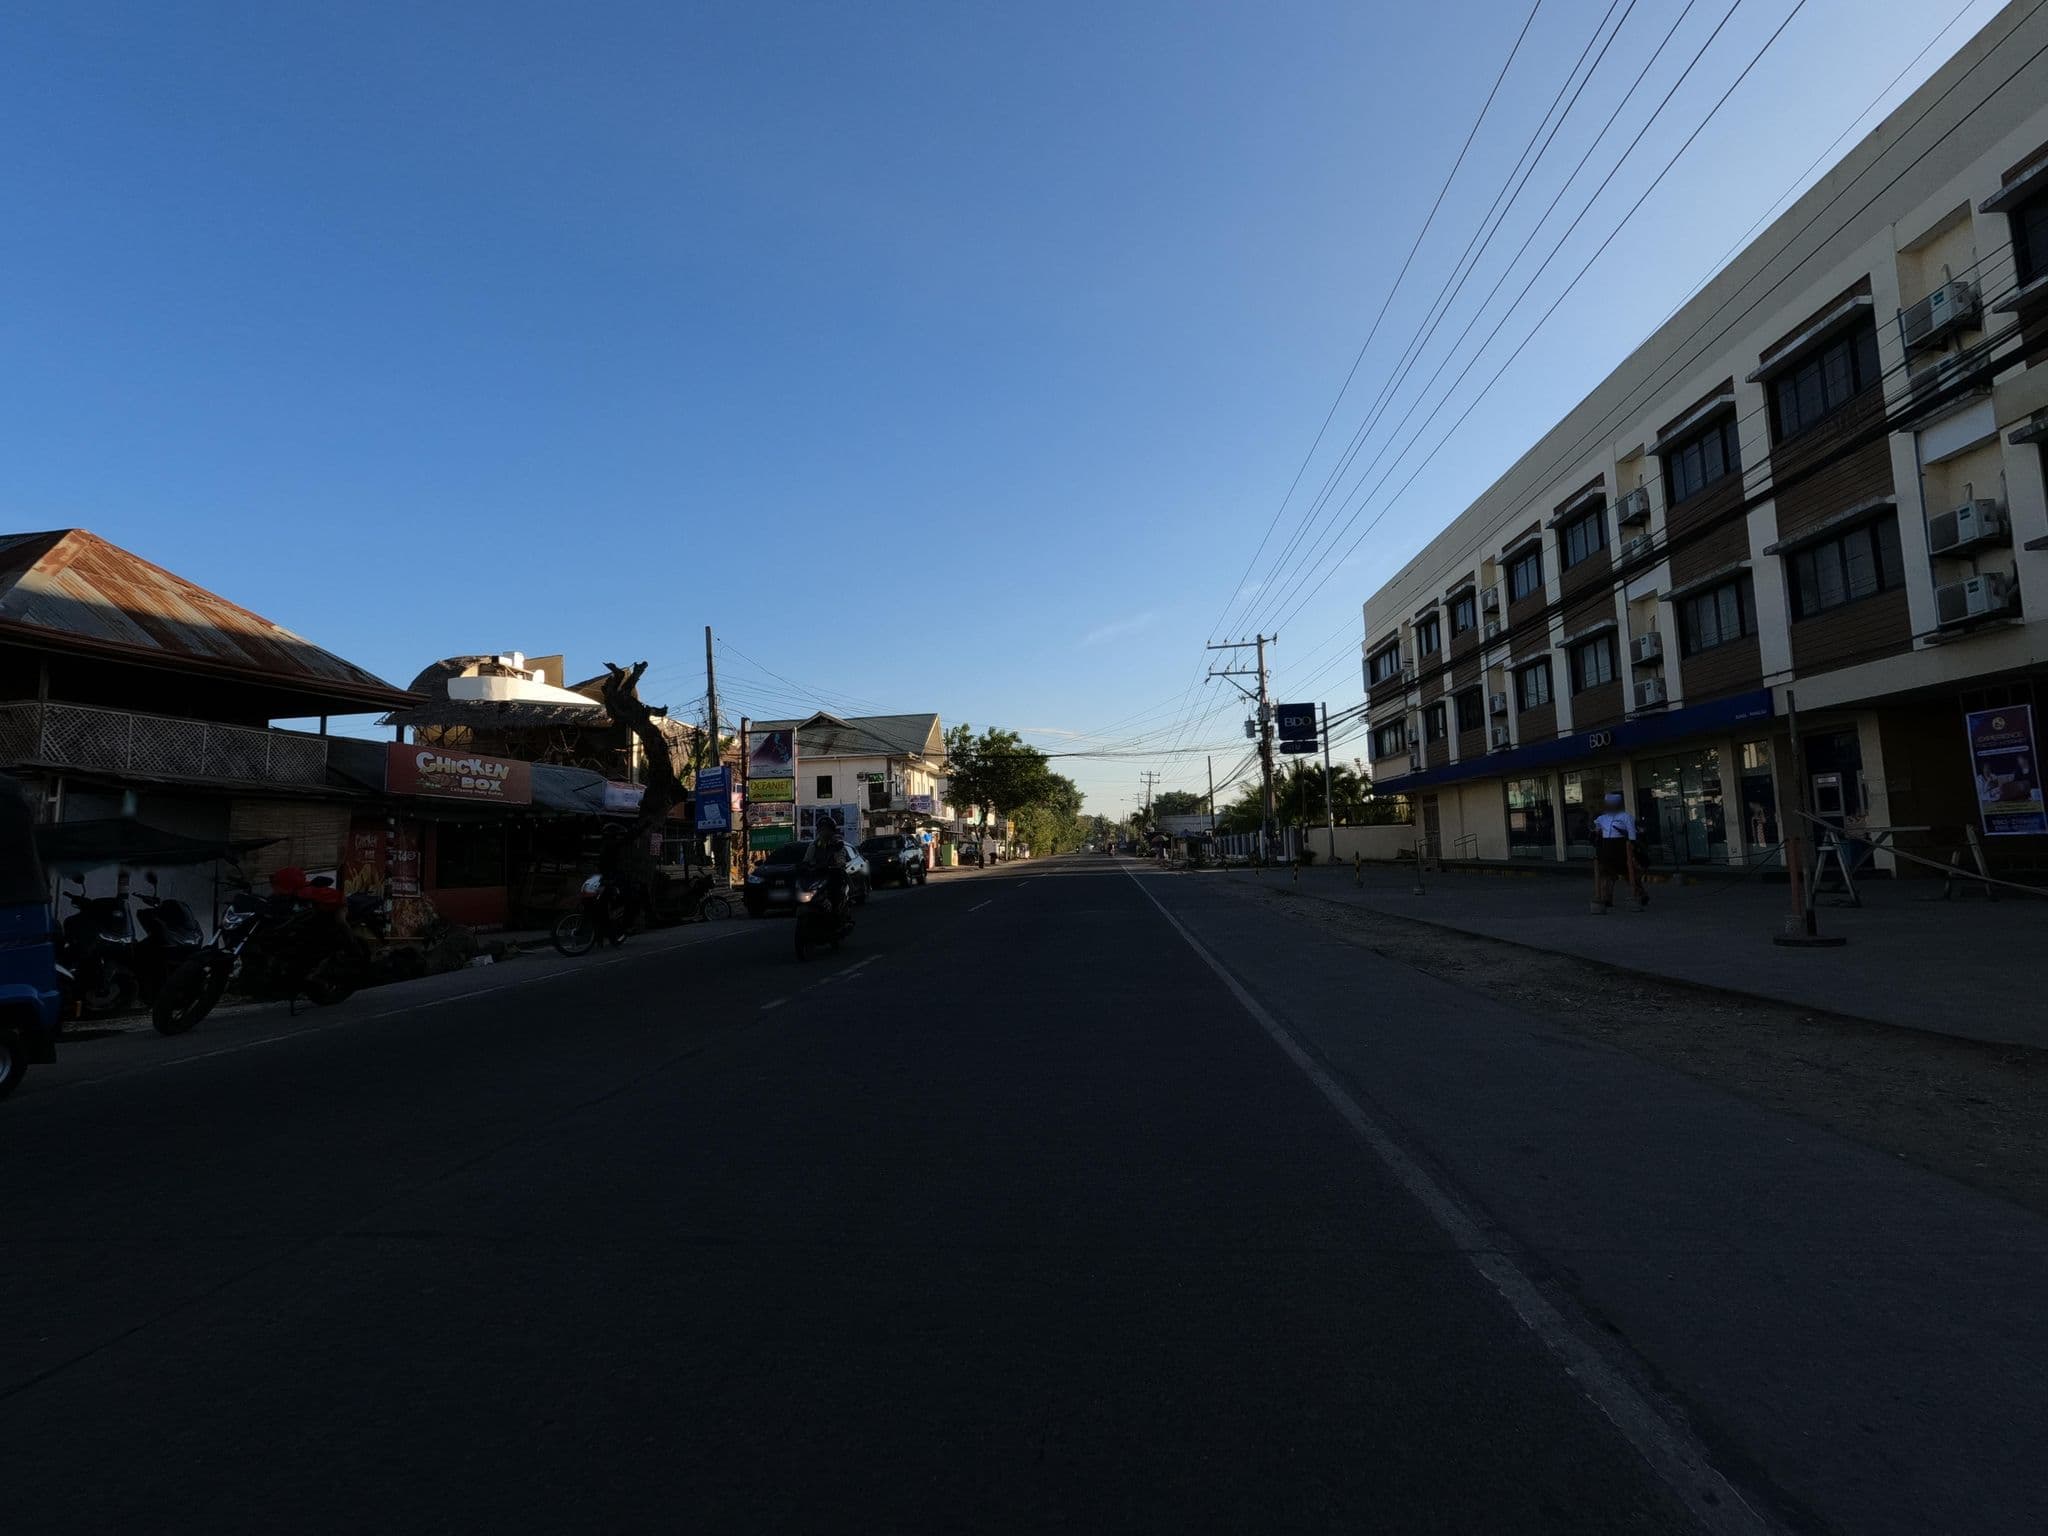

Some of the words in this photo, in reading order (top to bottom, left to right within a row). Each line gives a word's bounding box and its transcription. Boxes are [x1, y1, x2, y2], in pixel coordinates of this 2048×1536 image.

[1284, 716, 1312, 727] BDO
[1589, 733, 1611, 748] BDO
[417, 753, 509, 779] CHICKEN
[461, 777, 501, 791] BOX
